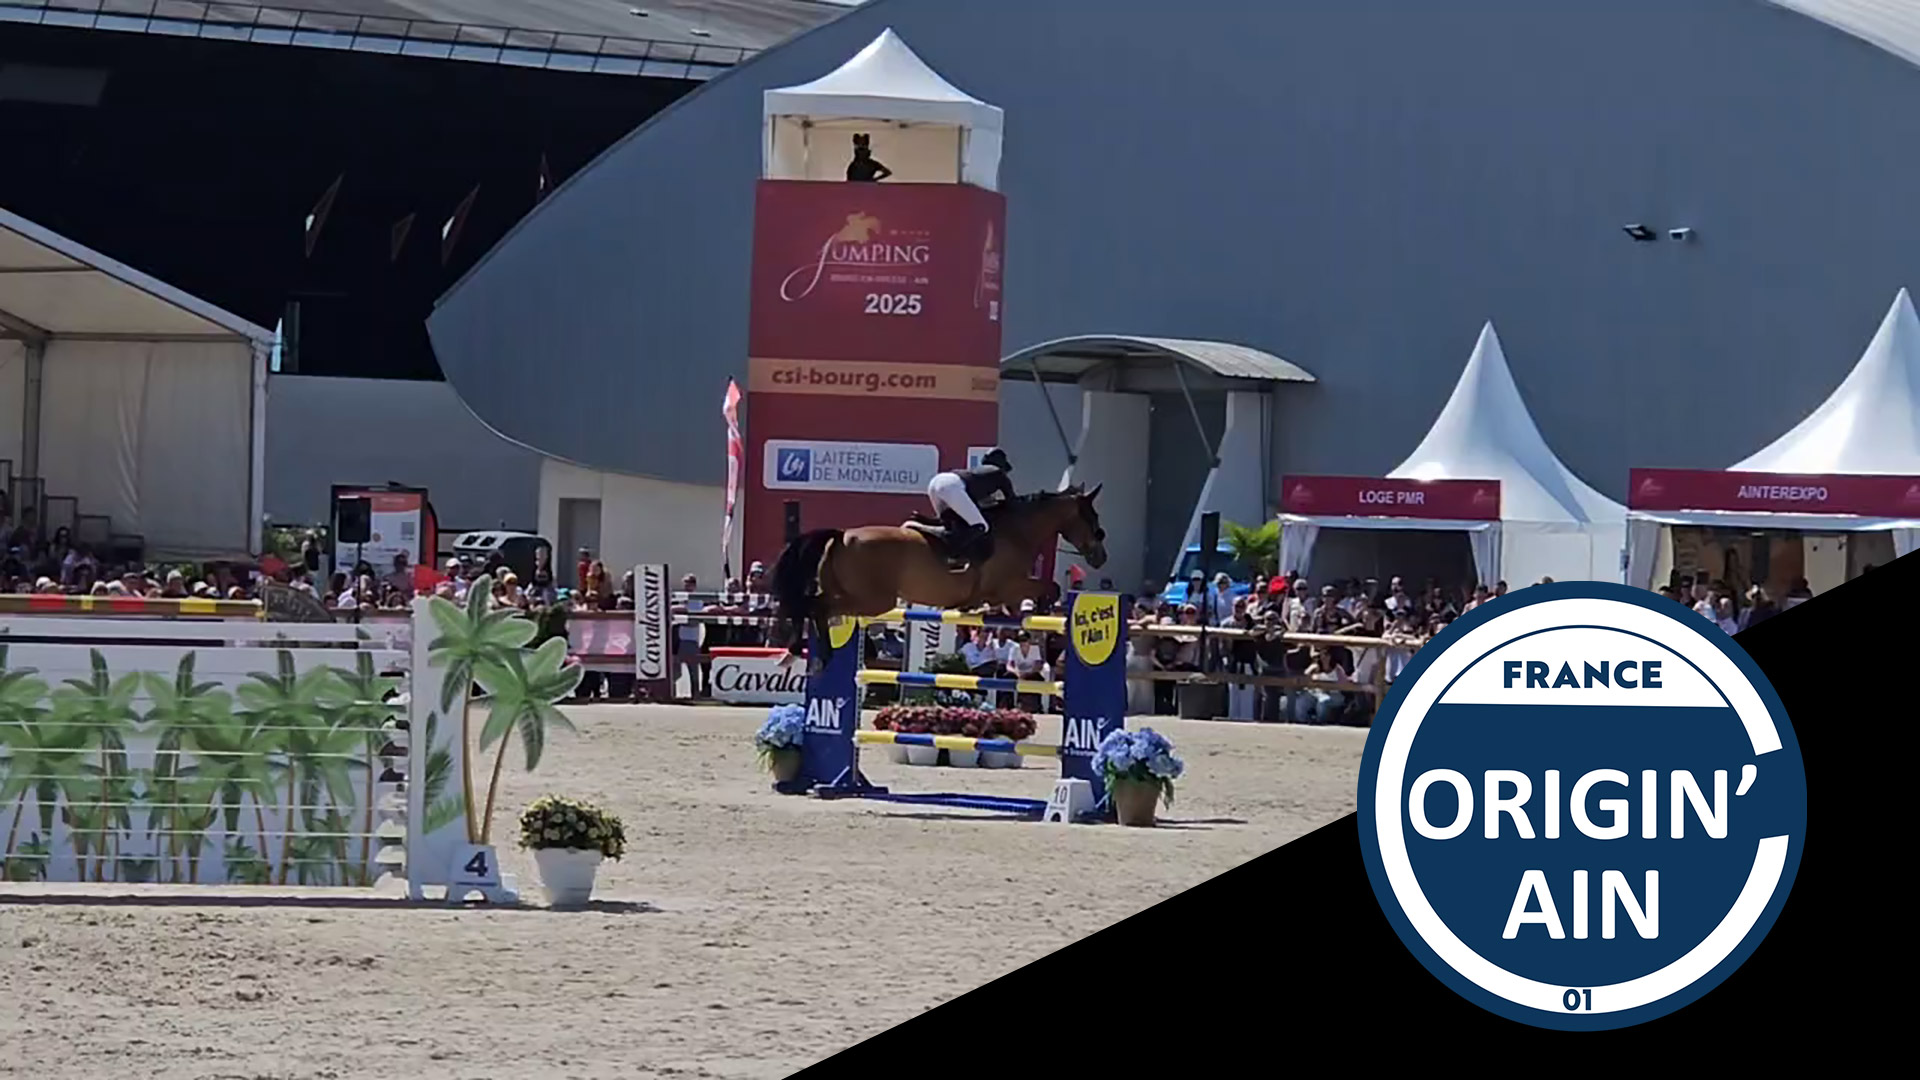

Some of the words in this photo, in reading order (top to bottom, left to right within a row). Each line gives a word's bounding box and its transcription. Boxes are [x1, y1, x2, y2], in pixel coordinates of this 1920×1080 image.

[865, 293, 922, 314] 2025
[772, 367, 936, 391] csi-bourg.com
[813, 450, 881, 466] LAITERIE
[813, 467, 833, 481] DE
[837, 467, 919, 484] MONTAIGU
[1359, 491, 1394, 503] LOGE
[1397, 492, 1425, 504] PMR
[1738, 486, 1828, 500] AINTEREXPO
[639, 566, 660, 678] Cavalassur
[1091, 604, 1114, 622] c'est
[806, 698, 840, 728] AIN
[1054, 786, 1068, 804] 10
[464, 851, 488, 877] 4
